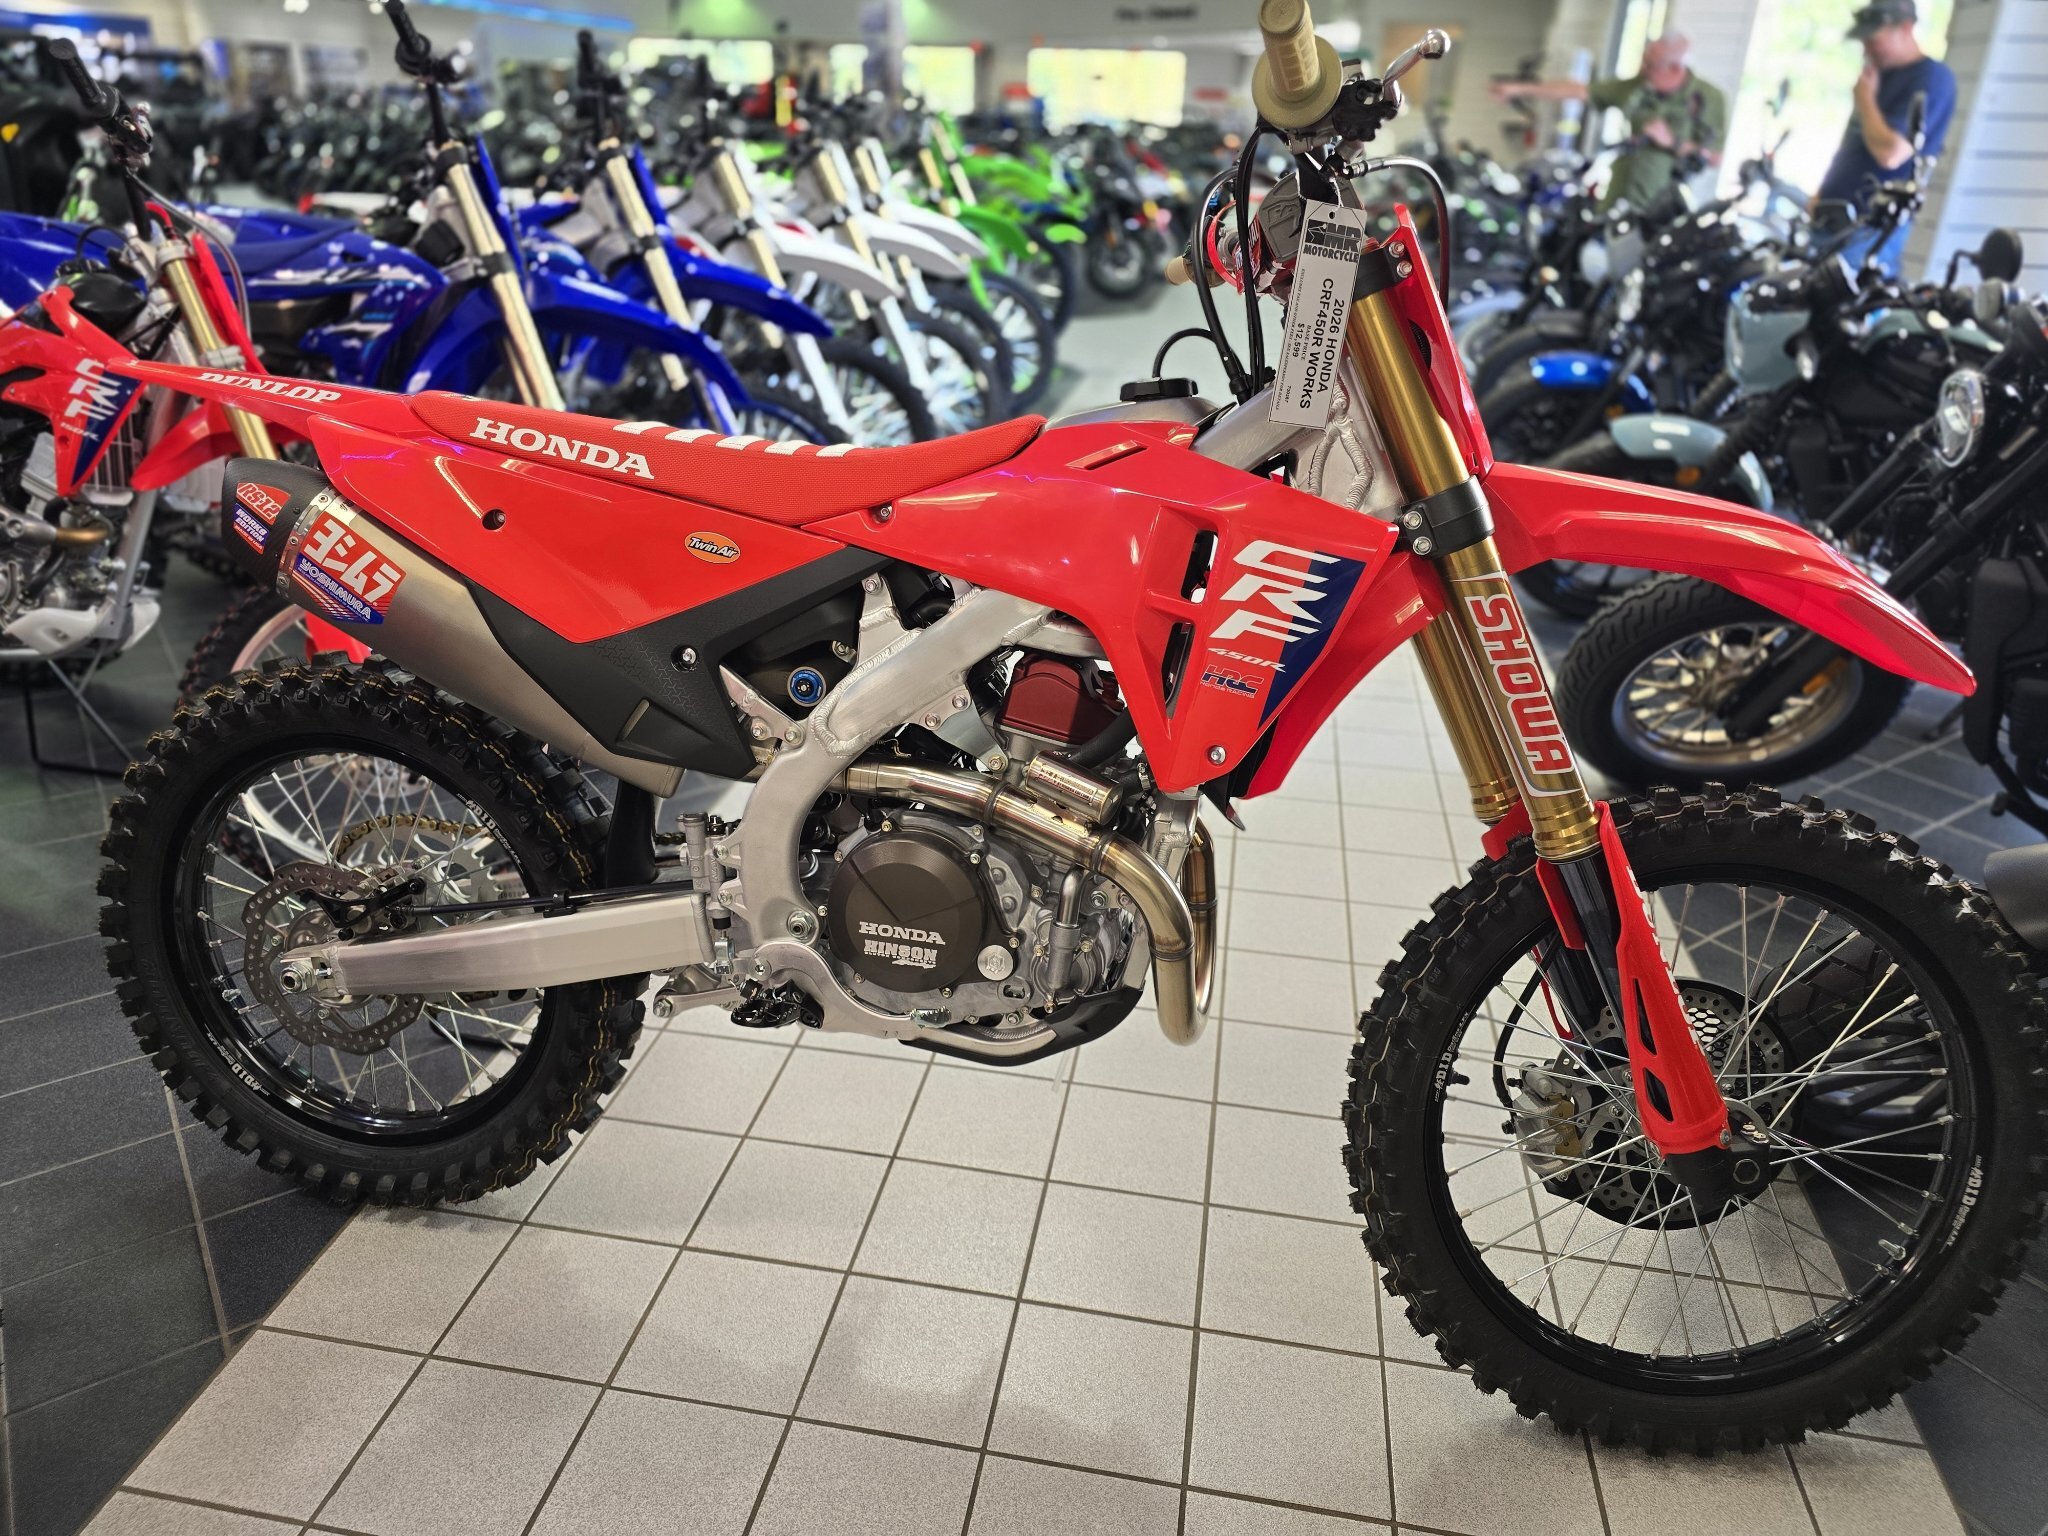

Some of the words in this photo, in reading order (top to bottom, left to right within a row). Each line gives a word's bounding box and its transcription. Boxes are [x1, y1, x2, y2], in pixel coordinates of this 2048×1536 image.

[1302, 244, 1360, 263] MOTORCYCLE
[1311, 277, 1335, 348] CRF450R
[1329, 298, 1345, 335] 2026
[1292, 322, 1305, 358] $12,599
[1299, 350, 1321, 410] WORKS
[1316, 337, 1338, 394] HONDA
[63, 357, 122, 421] CRF
[197, 372, 342, 403] DUNLOP
[469, 417, 655, 480] HONDA
[234, 517, 265, 543] EDITION
[235, 508, 268, 537] WORKS
[303, 518, 402, 604] ヨシムラ
[689, 537, 718, 553] Twin
[717, 546, 738, 558] Air
[300, 557, 373, 620] YOSHIMURA
[1208, 540, 1342, 643] CRF
[1207, 647, 1287, 673] 450R
[1201, 664, 1264, 695] HRC
[1464, 593, 1575, 775] SHOWA
[858, 921, 946, 946] HONDA
[864, 939, 938, 962] HINSON
